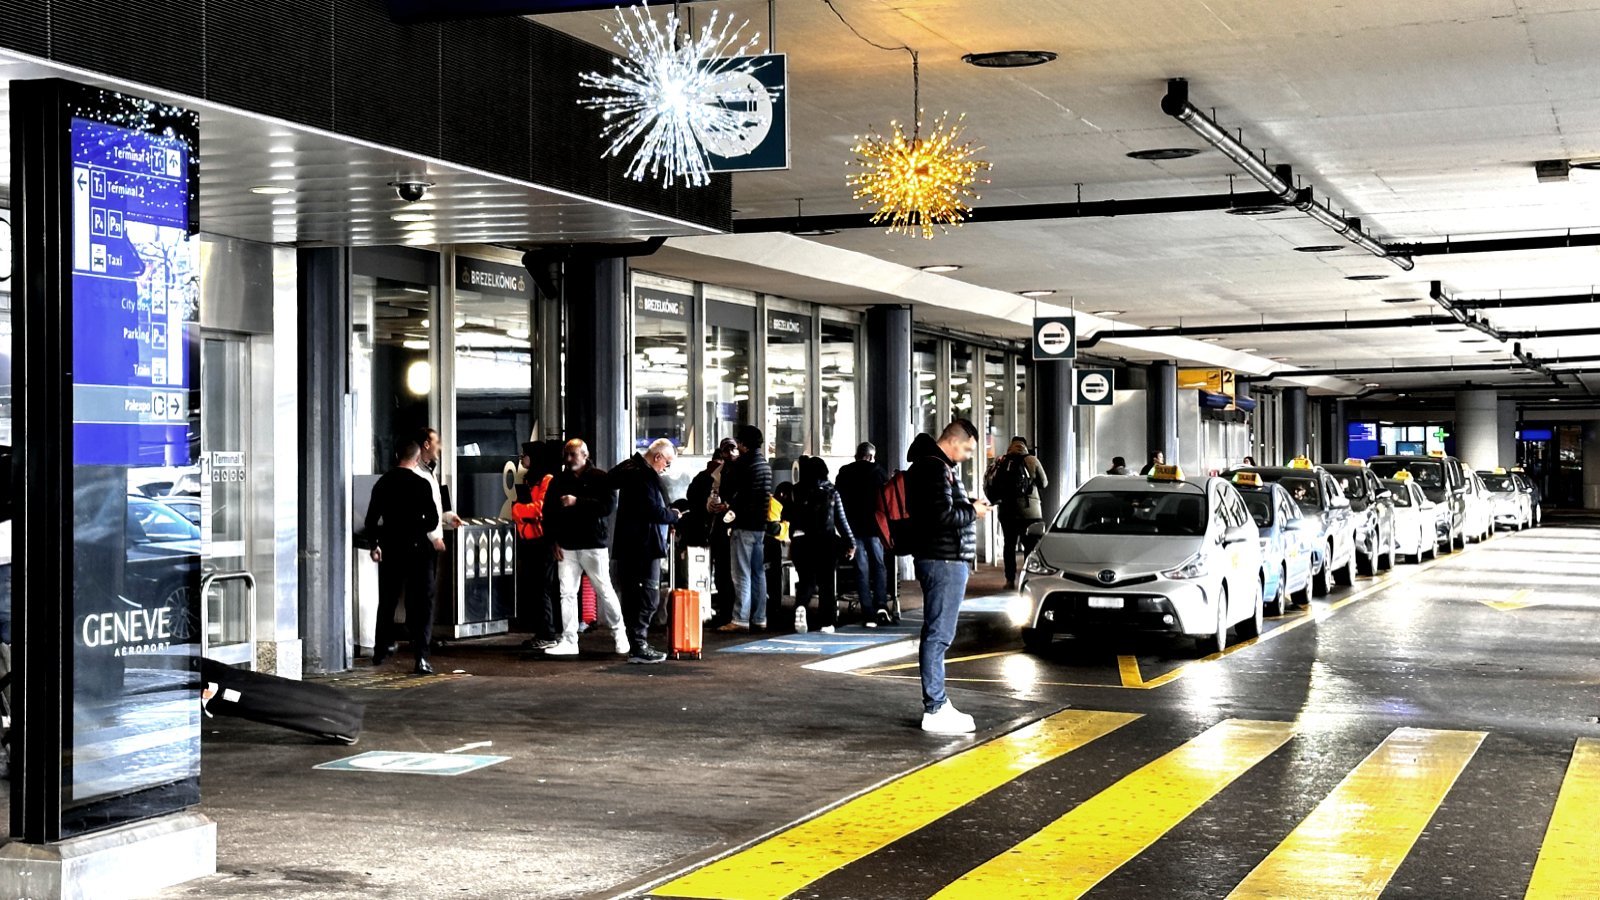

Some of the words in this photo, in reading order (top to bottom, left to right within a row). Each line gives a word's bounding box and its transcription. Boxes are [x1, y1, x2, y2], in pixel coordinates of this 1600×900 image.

[114, 146, 145, 162] Terminal
[107, 181, 138, 197] Terminal
[139, 186, 145, 198] 2
[107, 254, 123, 266] Taxi
[471, 271, 517, 290] BREZELKÖNIG
[121, 298, 136, 313] City
[124, 327, 150, 344] Parking
[1224, 371, 1232, 382] 2
